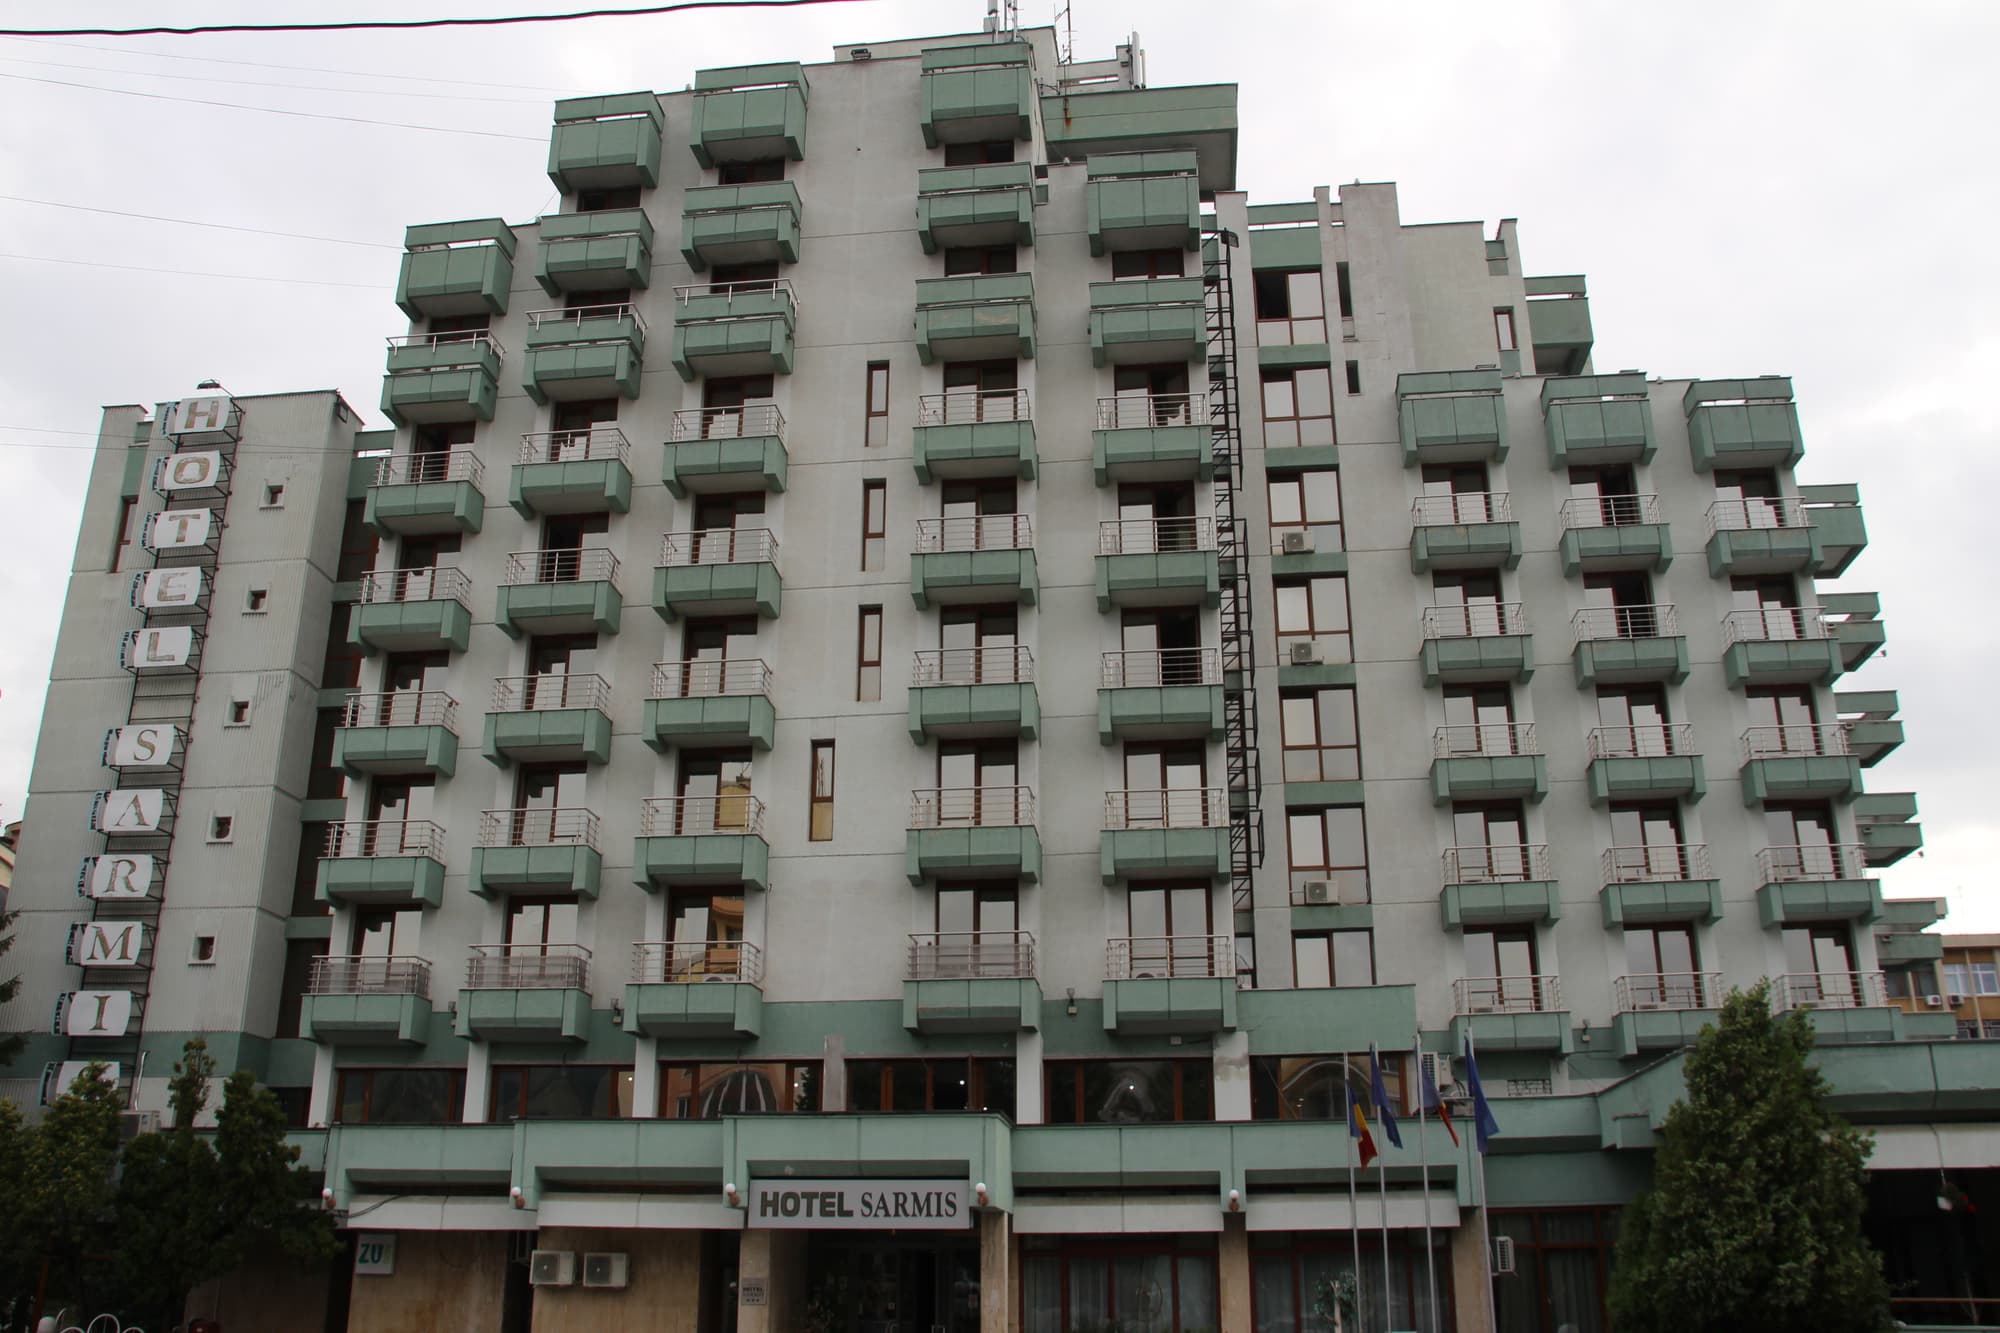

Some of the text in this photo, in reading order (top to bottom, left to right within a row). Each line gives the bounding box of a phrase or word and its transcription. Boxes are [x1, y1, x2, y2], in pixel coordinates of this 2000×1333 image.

[78, 400, 220, 1084] HOTEL SARMI
[760, 1191, 957, 1217] HOTEL SARMIS
